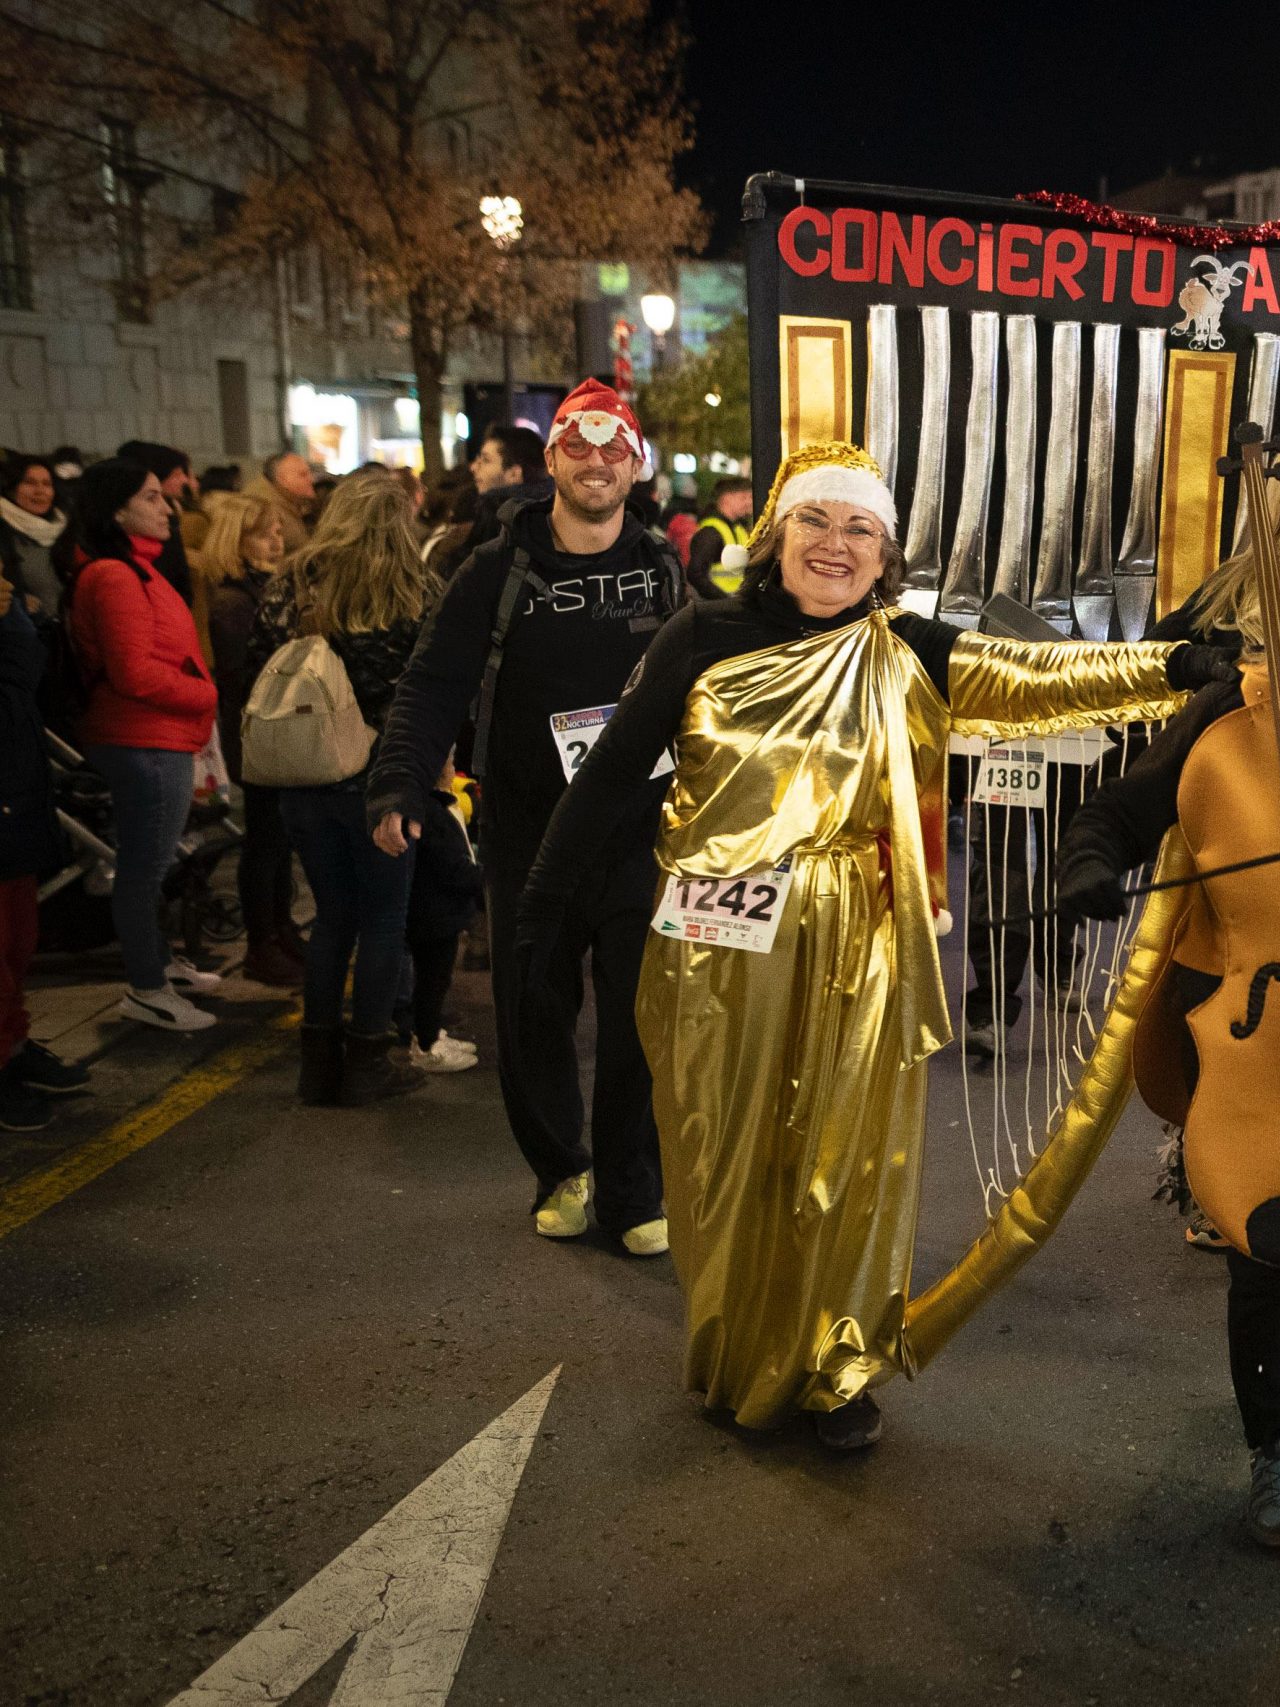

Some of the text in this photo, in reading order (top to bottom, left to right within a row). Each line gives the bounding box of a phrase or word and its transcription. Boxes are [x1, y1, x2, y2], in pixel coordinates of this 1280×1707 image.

[554, 714, 568, 732] 32
[566, 717, 605, 729] NOCTURNA
[987, 767, 1041, 791] 1380
[676, 880, 778, 922] 1242
